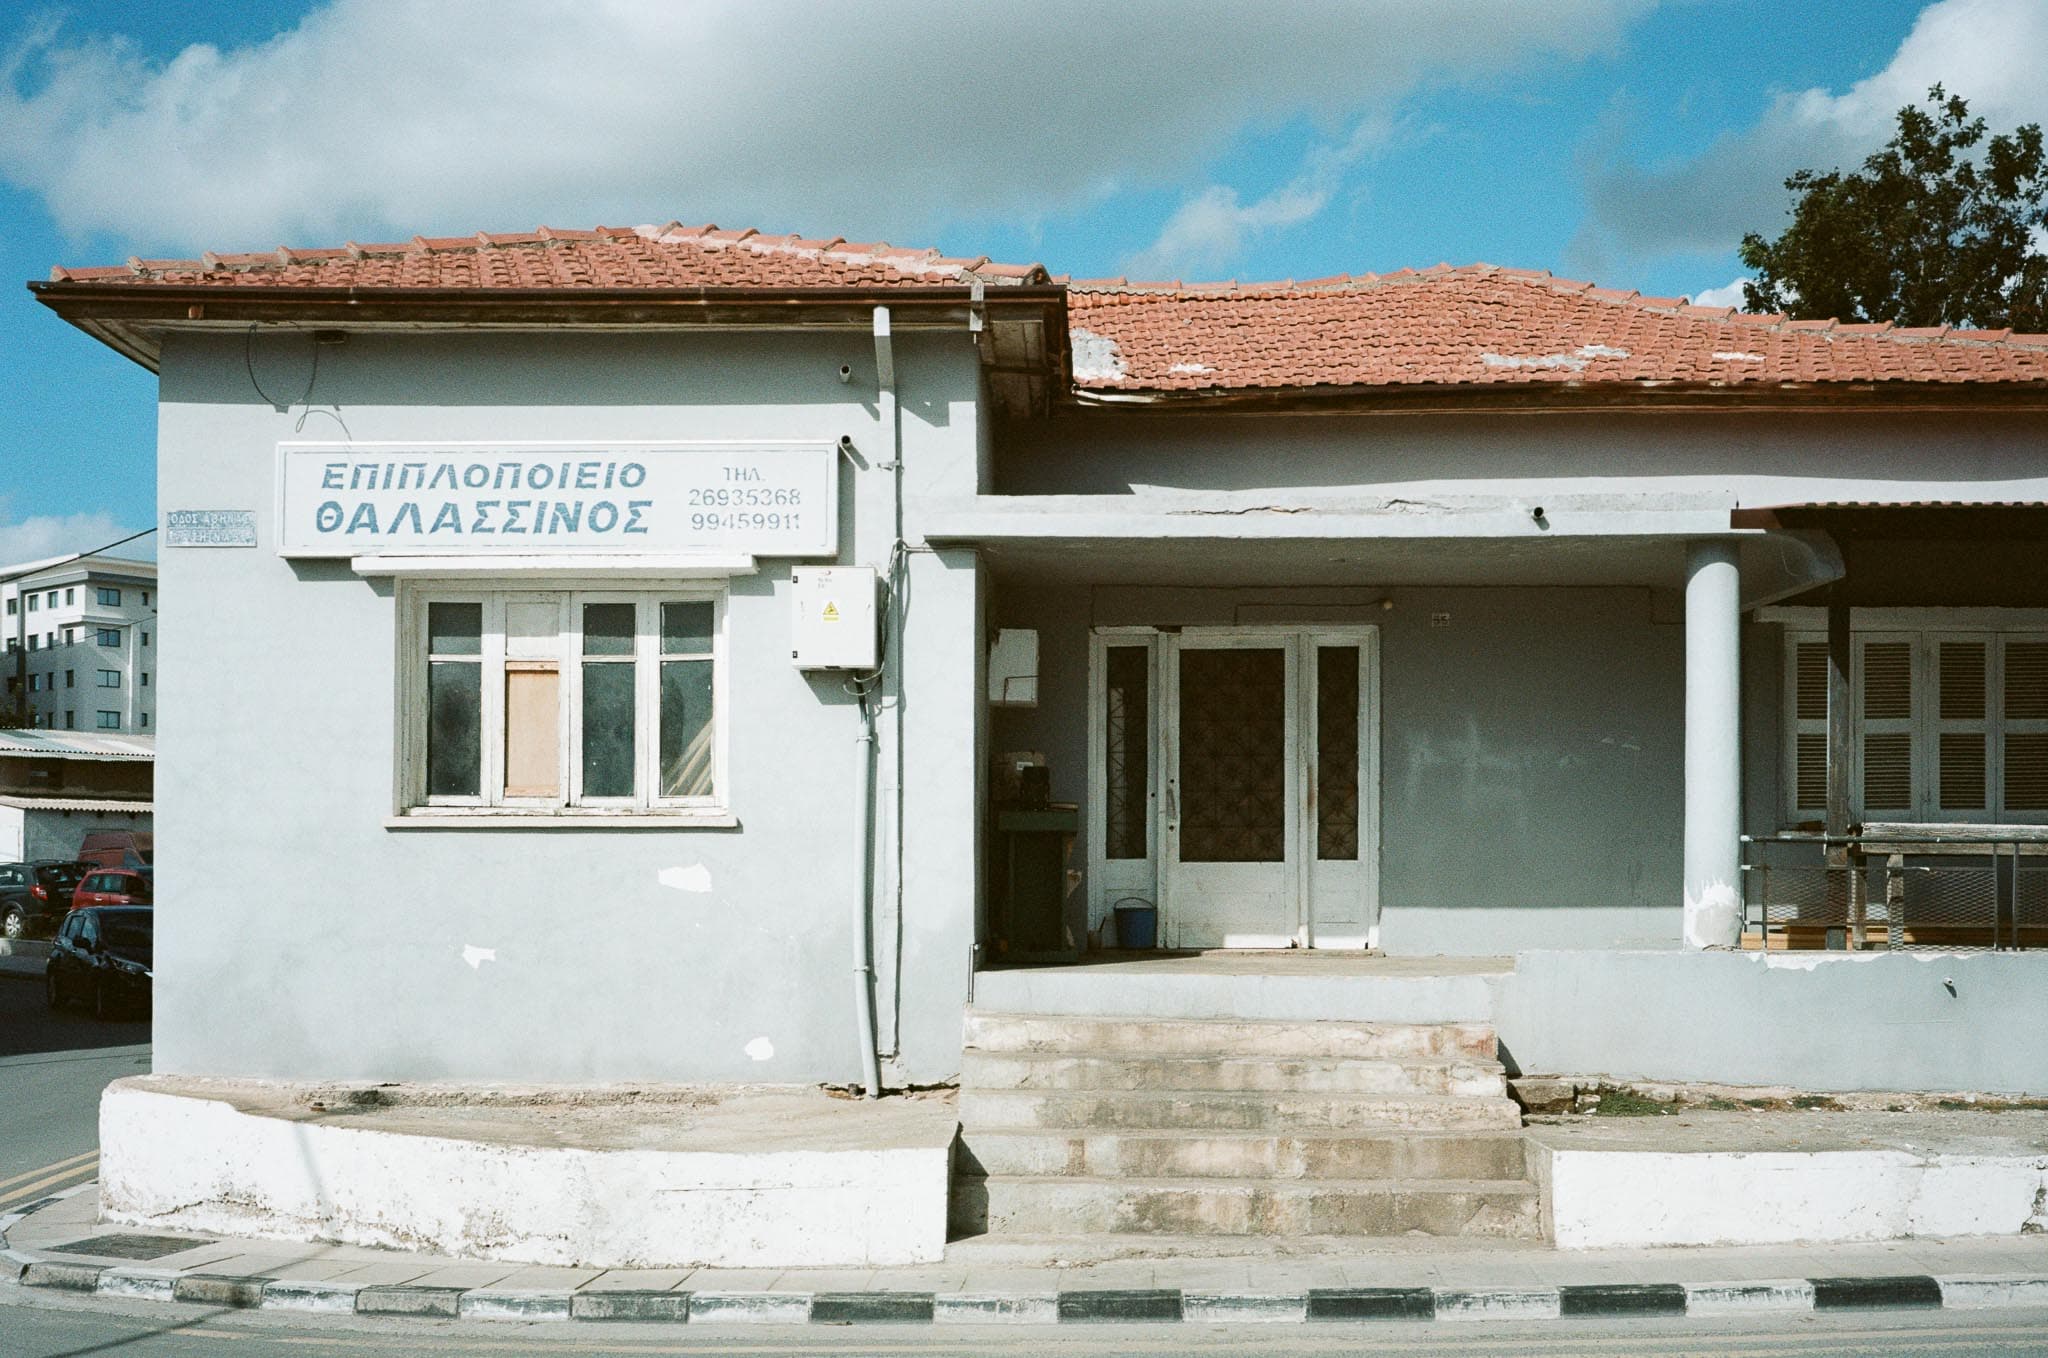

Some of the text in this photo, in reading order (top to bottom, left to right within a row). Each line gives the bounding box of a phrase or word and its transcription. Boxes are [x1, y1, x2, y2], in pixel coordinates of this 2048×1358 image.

[321, 462, 647, 490] ΕΠΙΠΛΟΠΟΙΕΙΟ
[722, 467, 767, 481] ΤΗΛ.
[688, 488, 801, 506] 26935368
[170, 513, 199, 525] ΟΔΟΣ
[315, 500, 653, 535] ΘΑΛΑΣΣΙΝΟΣ
[691, 513, 800, 531] 99459911
